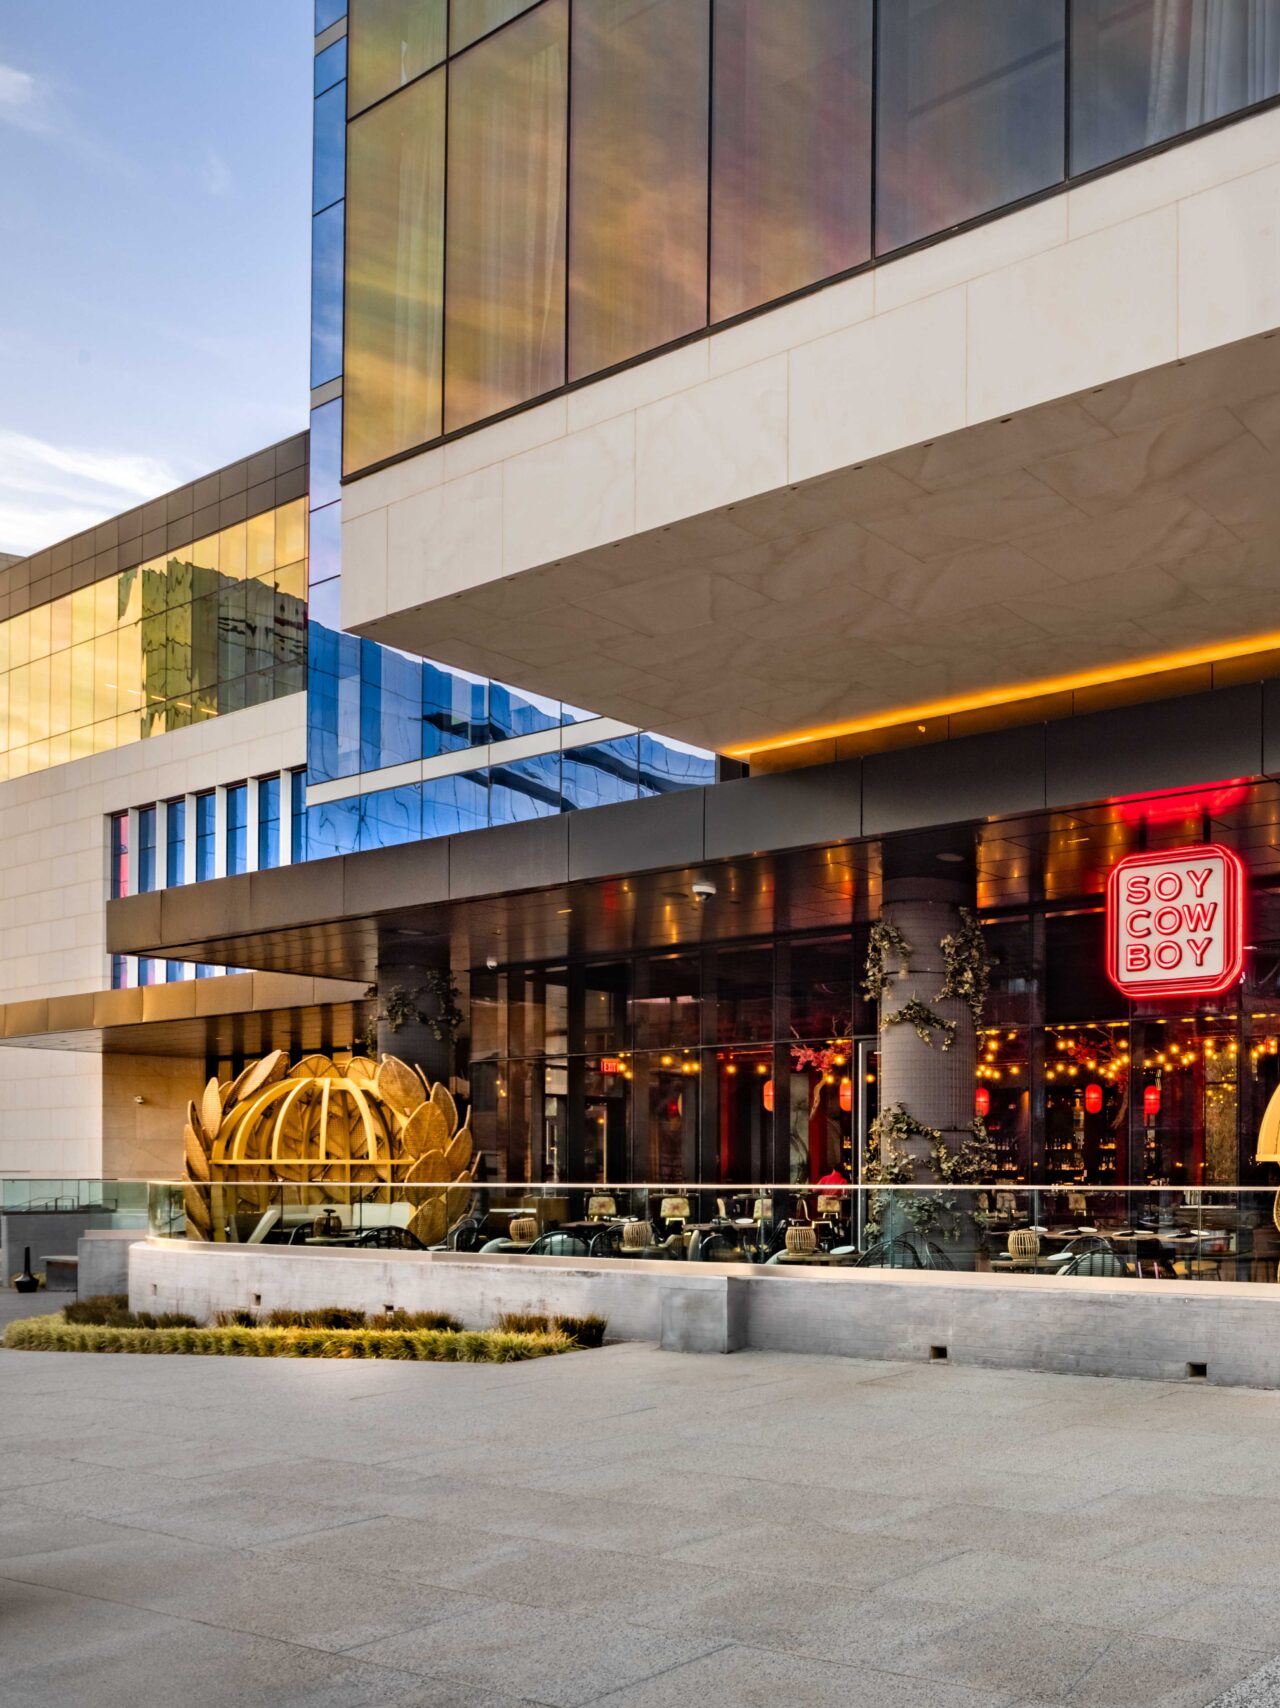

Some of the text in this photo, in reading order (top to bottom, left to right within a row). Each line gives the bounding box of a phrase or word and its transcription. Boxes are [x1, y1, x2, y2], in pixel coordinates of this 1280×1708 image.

[1126, 868, 1213, 905] SOY
[1126, 902, 1218, 938] COW
[1126, 937, 1213, 972] BOY
